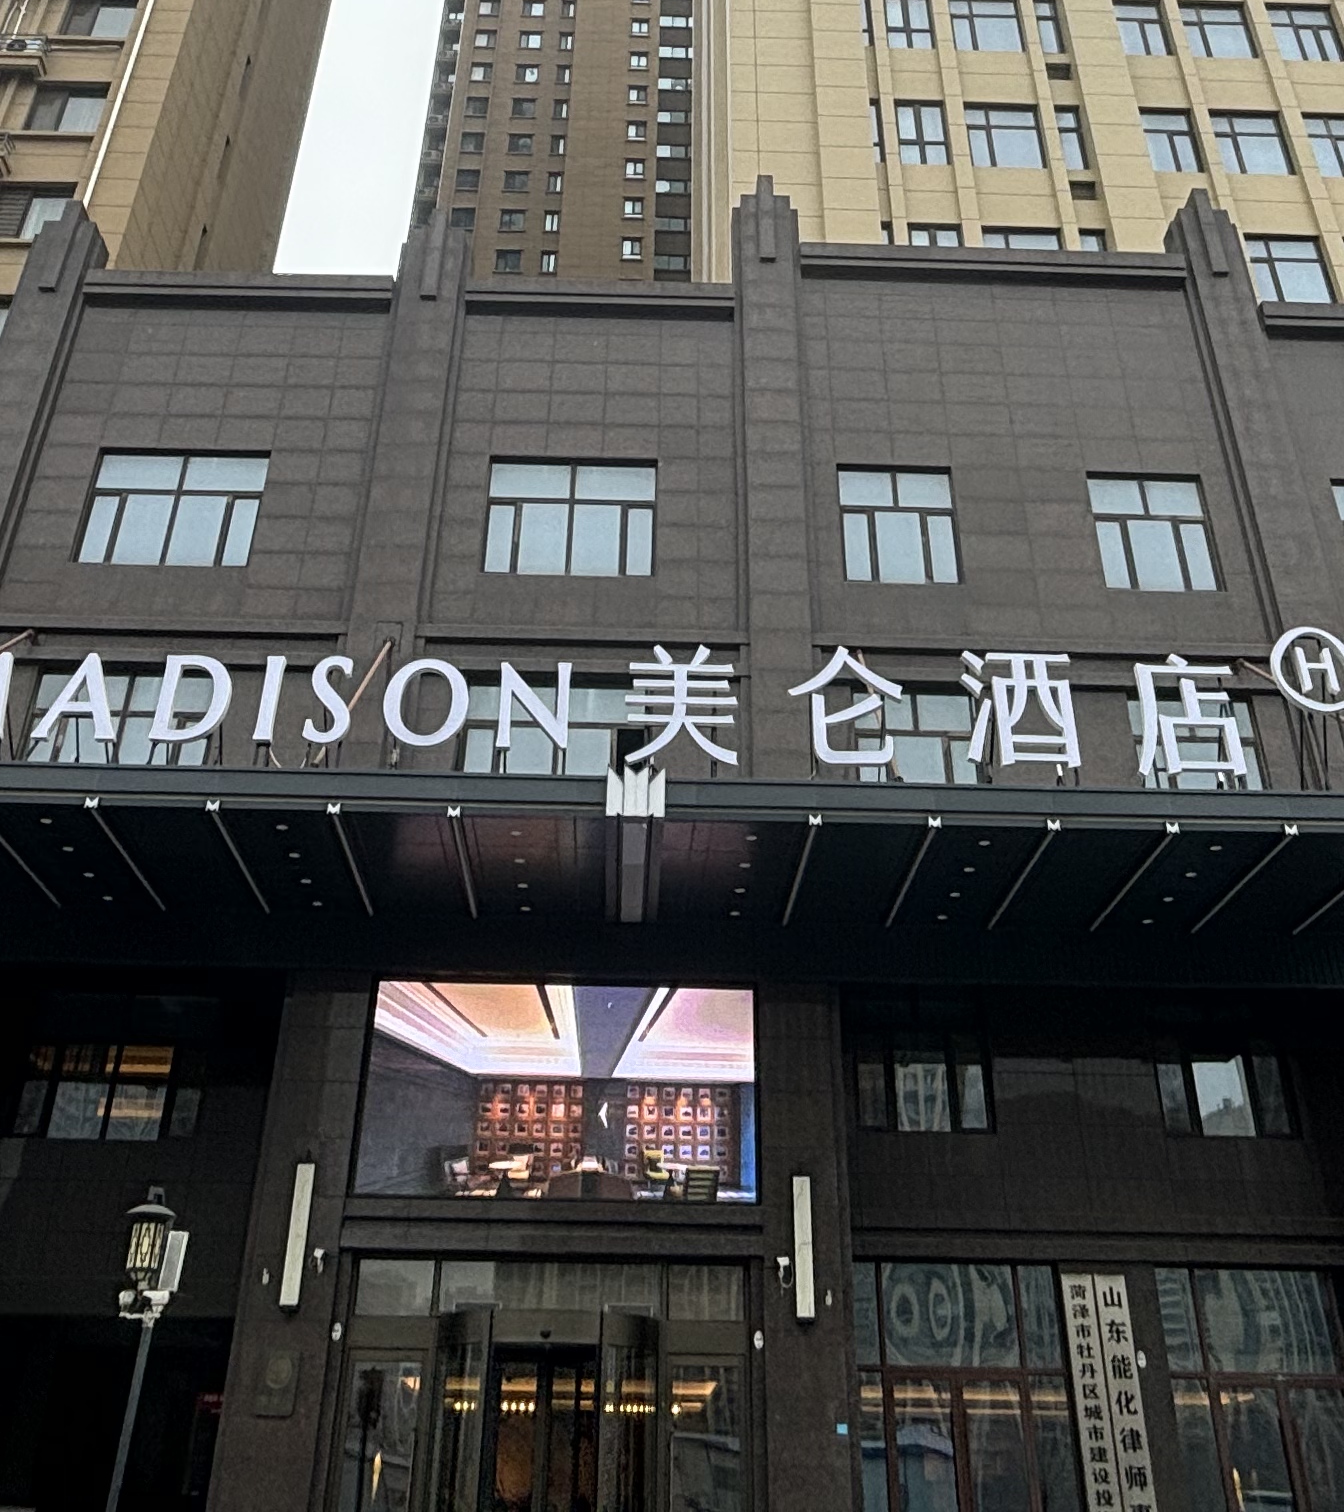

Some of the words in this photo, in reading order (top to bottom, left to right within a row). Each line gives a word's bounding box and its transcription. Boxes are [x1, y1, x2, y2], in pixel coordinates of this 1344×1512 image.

[624, 644, 1248, 778] 美仑酒店
[1069, 1284, 1115, 1512] 菏泽市牡丹区城市建设投
